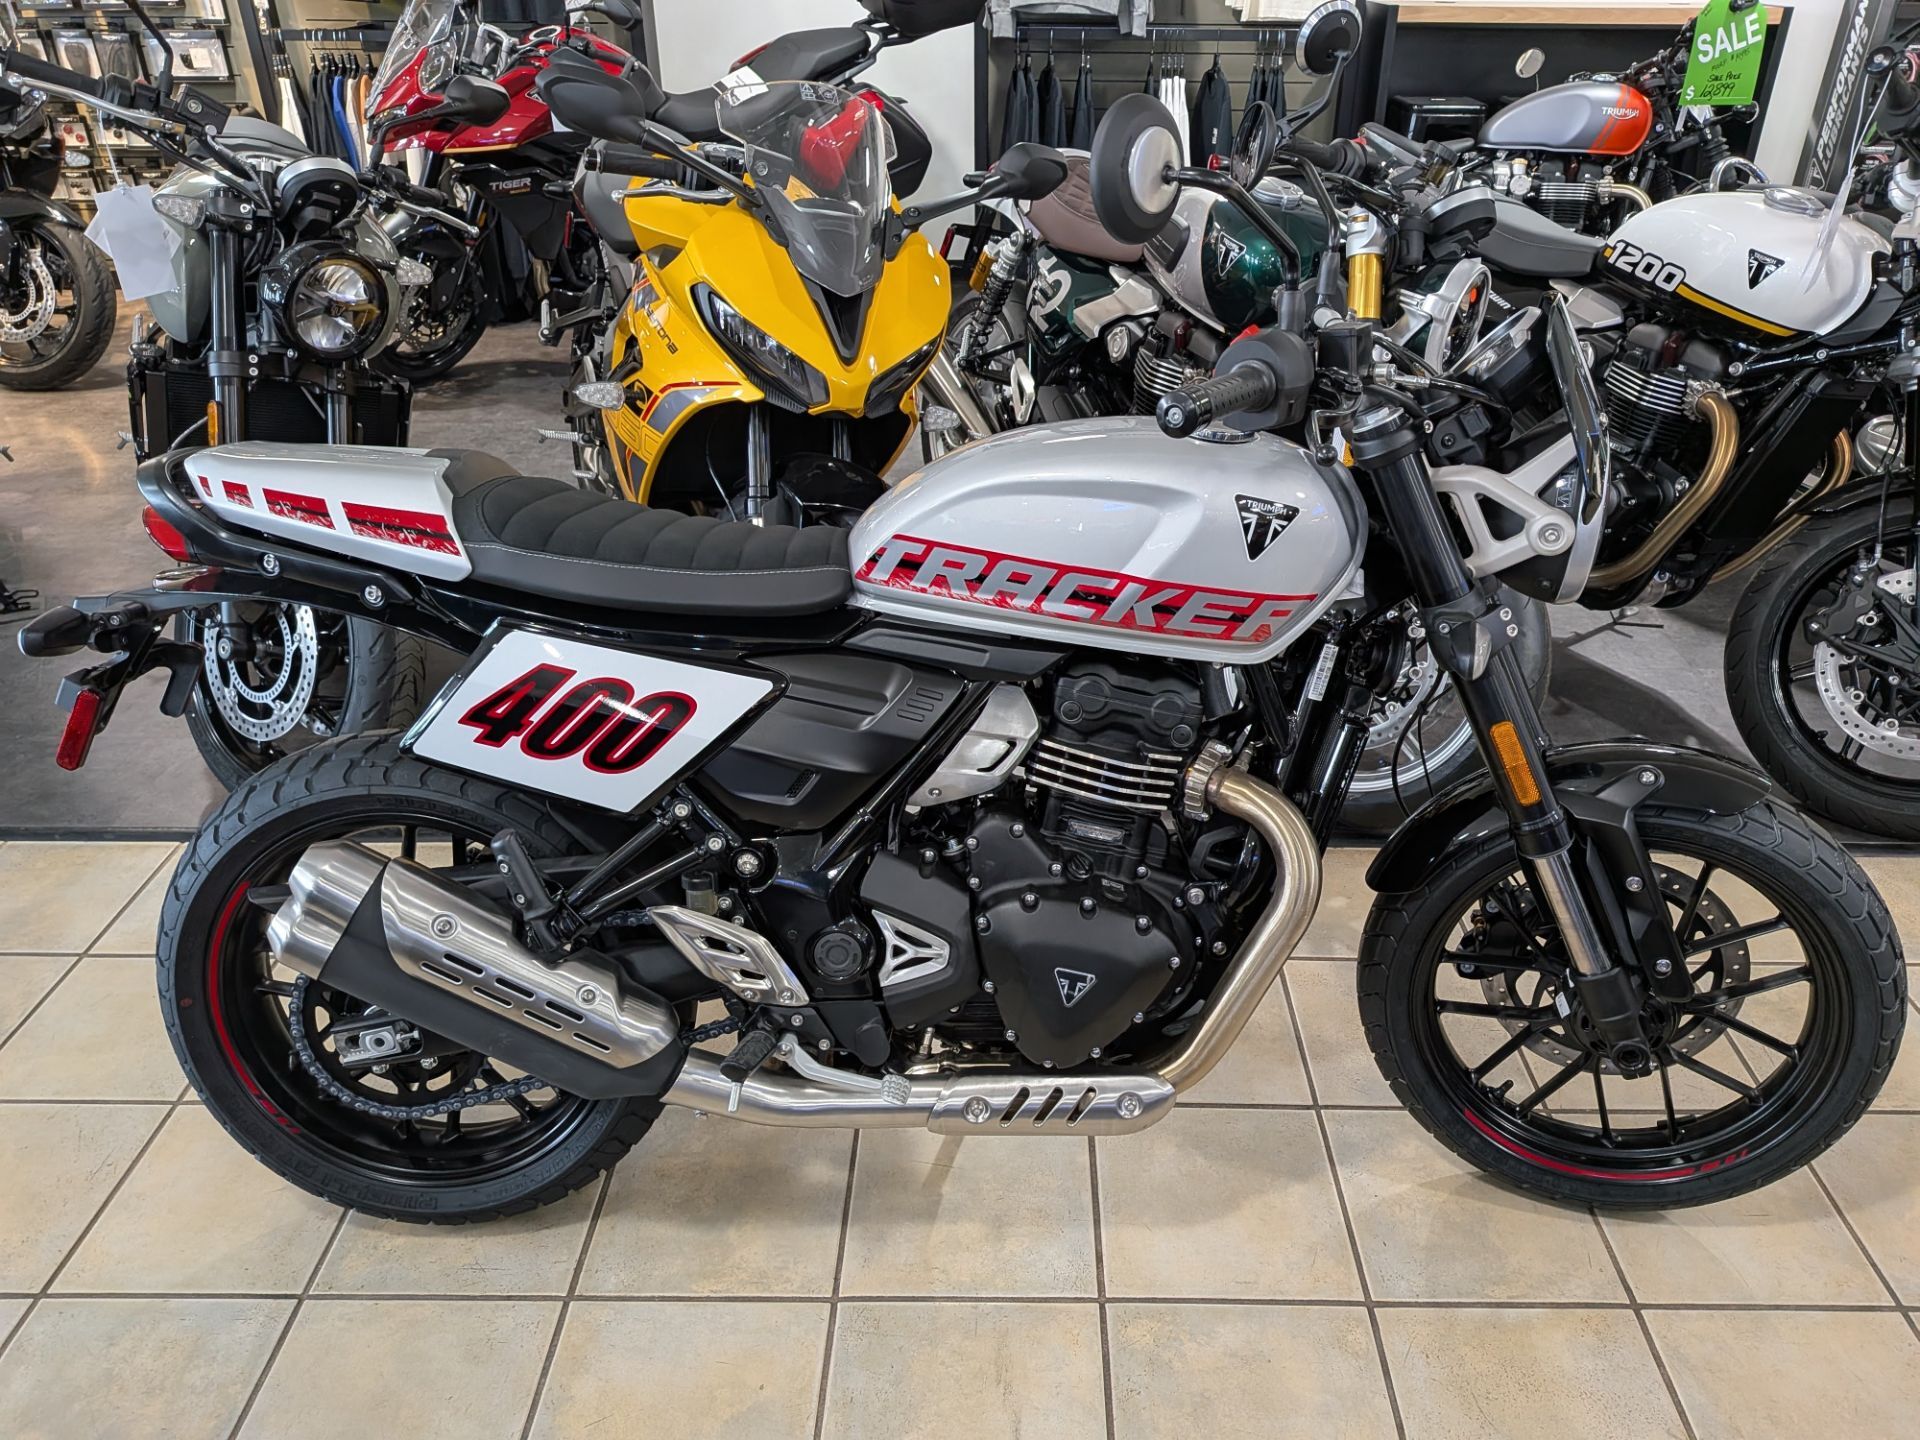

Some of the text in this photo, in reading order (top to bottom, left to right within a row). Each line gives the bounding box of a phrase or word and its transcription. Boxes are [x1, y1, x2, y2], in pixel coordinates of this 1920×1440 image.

[1697, 12, 1762, 64] SALE
[1601, 106, 1640, 118] TRIUMPH
[1822, 23, 1869, 172] LUBRICANTS
[489, 177, 532, 191] TIGER
[1607, 241, 1685, 293] 1200
[1246, 499, 1287, 516] TRIUMPH
[868, 539, 1297, 641] TRACKER
[458, 662, 698, 774] 400
